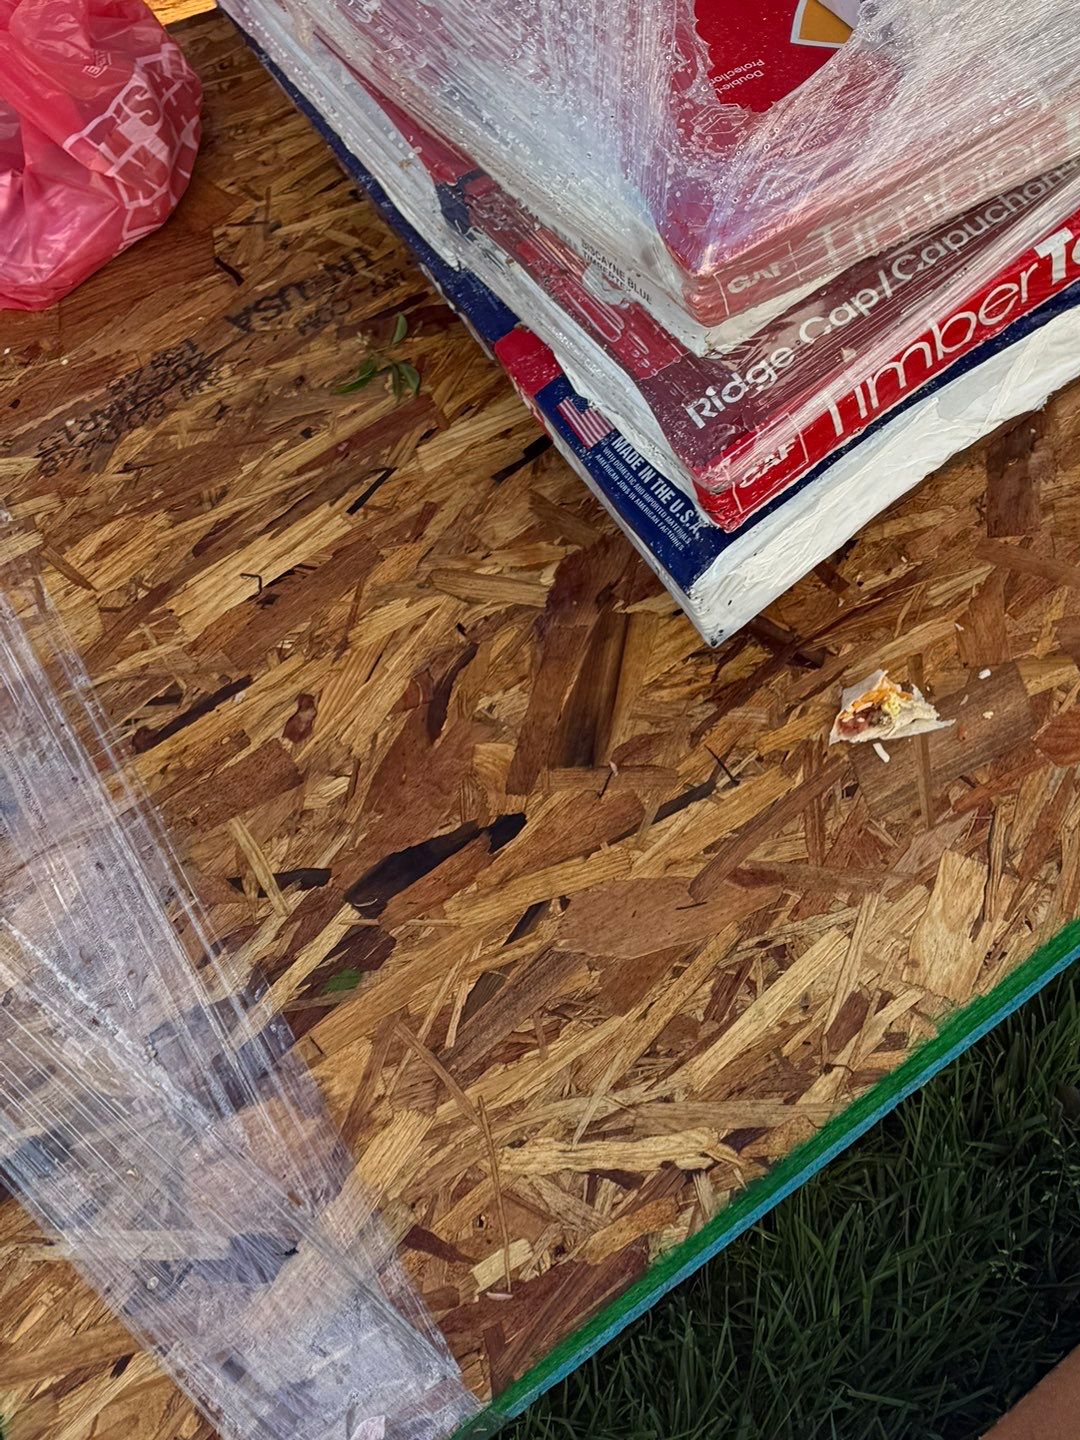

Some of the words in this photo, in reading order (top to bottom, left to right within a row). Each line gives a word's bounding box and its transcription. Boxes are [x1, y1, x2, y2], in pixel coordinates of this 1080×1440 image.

[726, 262, 789, 294] GAF
[684, 345, 795, 430] Ridge
[594, 453, 620, 482] AMERICAN
[617, 479, 631, 496] JOBS
[634, 498, 661, 525] AMERICAN
[657, 519, 685, 551] FACTORIES
[611, 435, 645, 471] MADE
[637, 465, 657, 485] IN
[650, 477, 676, 505] THE
[612, 459, 637, 486] DOMESTIC
[634, 483, 645, 498] AND
[642, 492, 667, 519] IMPORTED
[664, 513, 692, 545] MATERIALS
[739, 438, 797, 489] GAF
